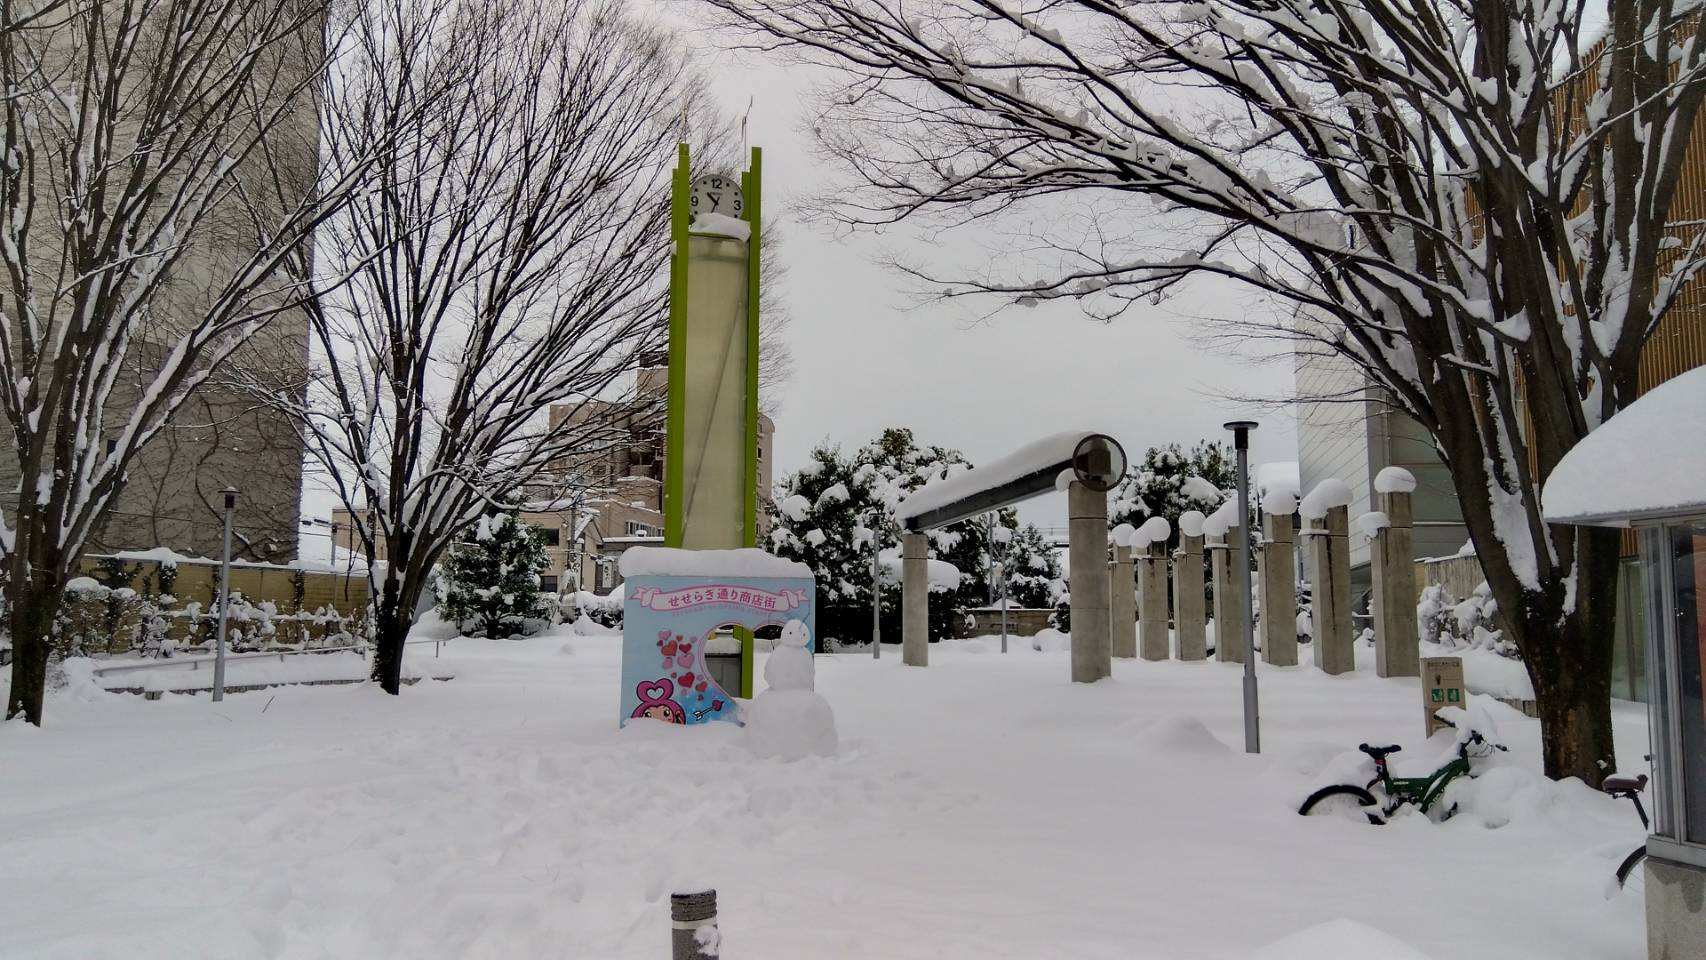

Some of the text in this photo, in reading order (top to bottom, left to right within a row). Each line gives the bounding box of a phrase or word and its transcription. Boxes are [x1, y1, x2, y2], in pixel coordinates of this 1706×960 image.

[711, 178, 722, 188] 12
[691, 196, 698, 206] 9
[734, 200, 741, 210] 3
[668, 588, 776, 608] せせらぎ通り商店街
